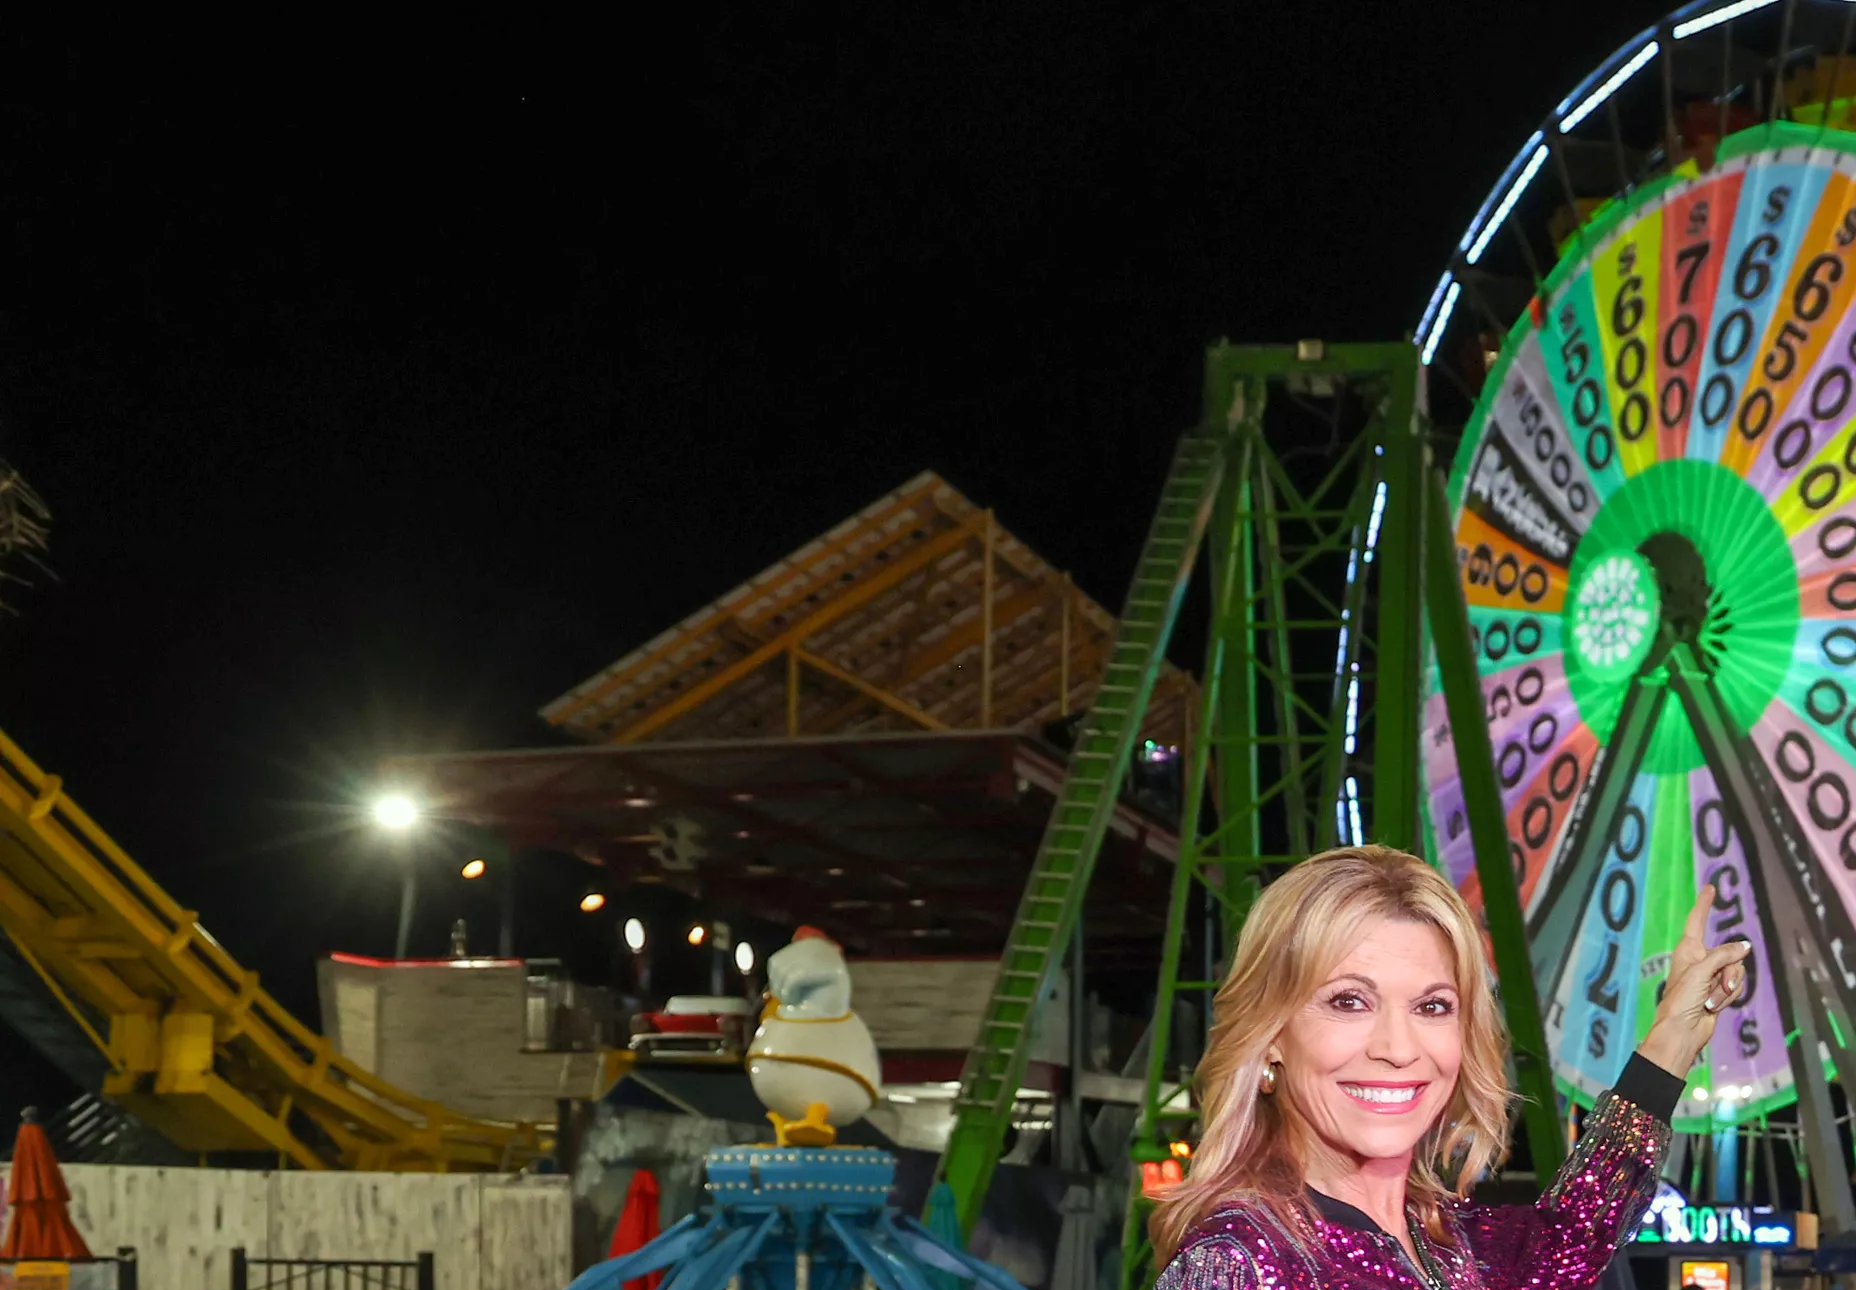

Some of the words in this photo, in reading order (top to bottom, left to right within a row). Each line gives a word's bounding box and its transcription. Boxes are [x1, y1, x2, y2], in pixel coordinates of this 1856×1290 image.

[1612, 242, 1649, 440] $600
[1661, 201, 1710, 428] $700
[1701, 186, 1791, 427] $600
[1586, 805, 1646, 1059] $700
